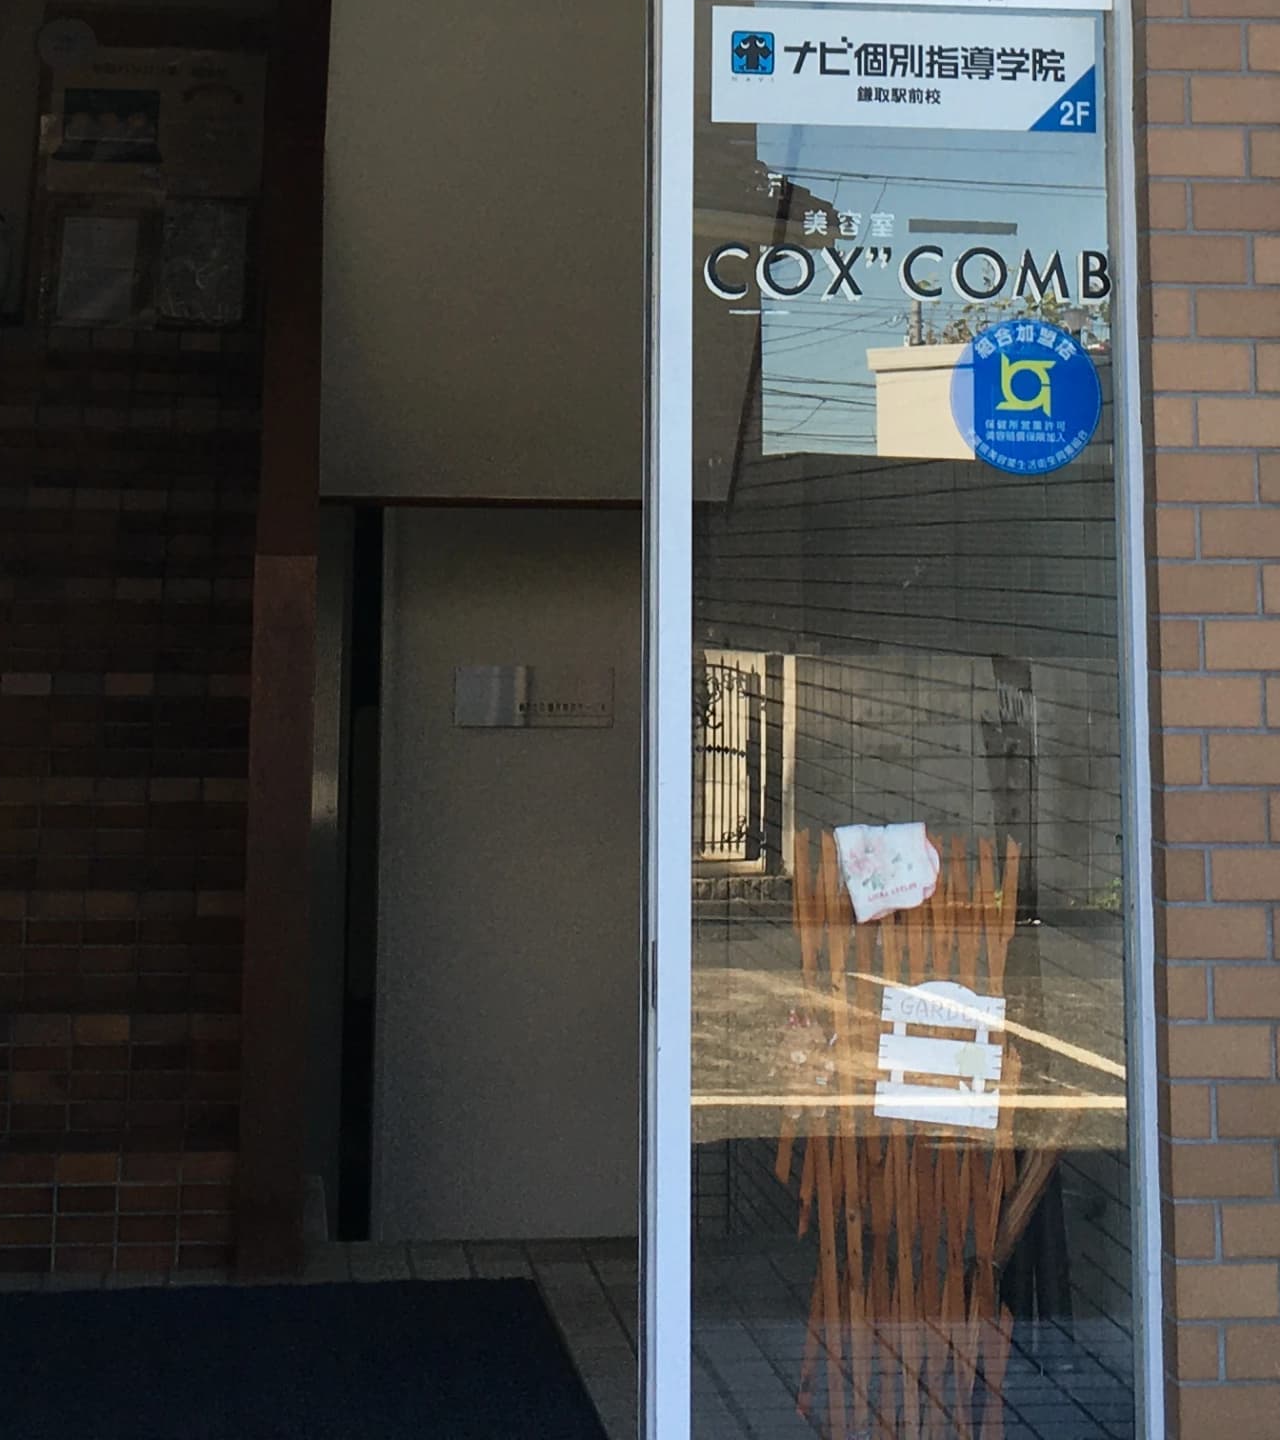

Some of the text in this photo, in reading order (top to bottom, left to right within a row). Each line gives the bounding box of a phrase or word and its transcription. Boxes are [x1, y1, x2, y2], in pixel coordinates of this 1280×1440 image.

[784, 36, 1066, 83] ナビ個別指導学院
[857, 86, 941, 105] 鎌取駅前校
[1060, 101, 1091, 127] 2F
[803, 210, 895, 238] 美容室
[974, 324, 1077, 361] 組合加盟店
